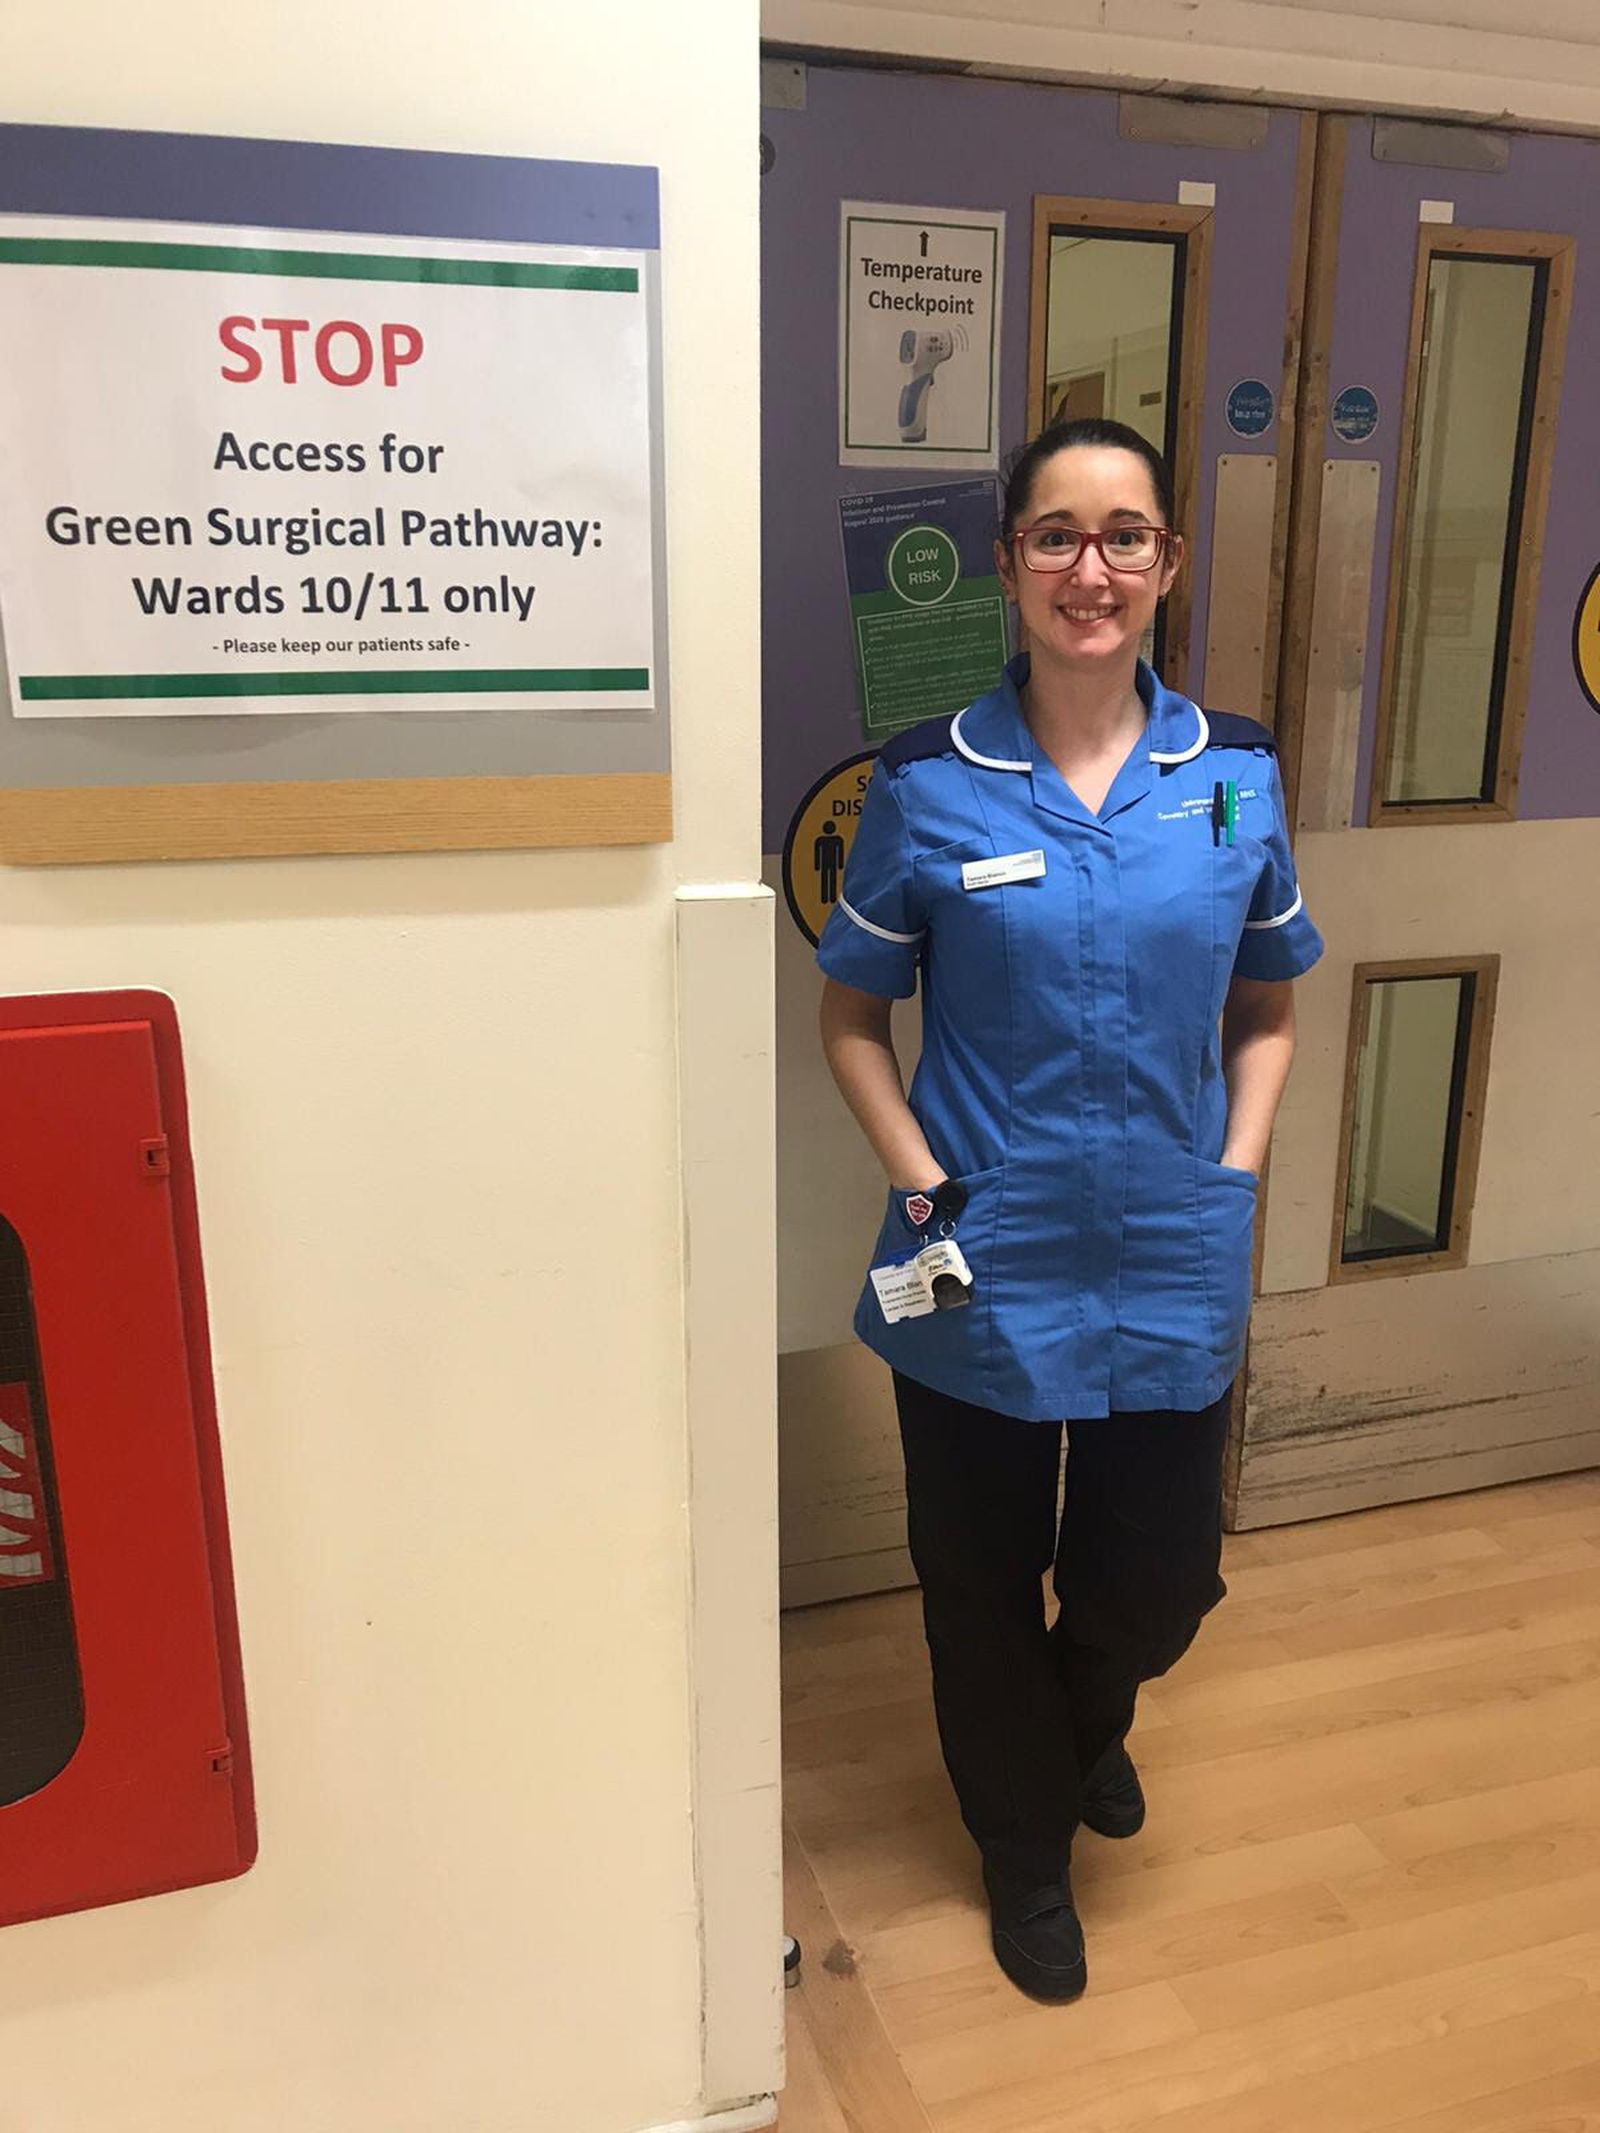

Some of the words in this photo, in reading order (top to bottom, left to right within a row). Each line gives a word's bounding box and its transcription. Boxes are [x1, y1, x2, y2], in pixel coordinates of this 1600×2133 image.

[861, 257, 983, 284] Temperature
[868, 289, 975, 317] Checkpoint
[218, 315, 424, 389] STOP
[213, 432, 366, 474] Access
[379, 433, 444, 474] for
[46, 506, 192, 546] Green
[207, 507, 386, 556] Surgical
[402, 508, 602, 557] Pathway:
[906, 548, 939, 564] LOW
[908, 569, 941, 585] RISK
[132, 575, 285, 616] Wards
[300, 572, 430, 621] 10/11
[444, 575, 536, 622] only
[223, 637, 277, 653] Please
[281, 637, 321, 655] keep
[325, 640, 353, 653] our
[358, 637, 424, 655] patients
[427, 636, 460, 651] safe
